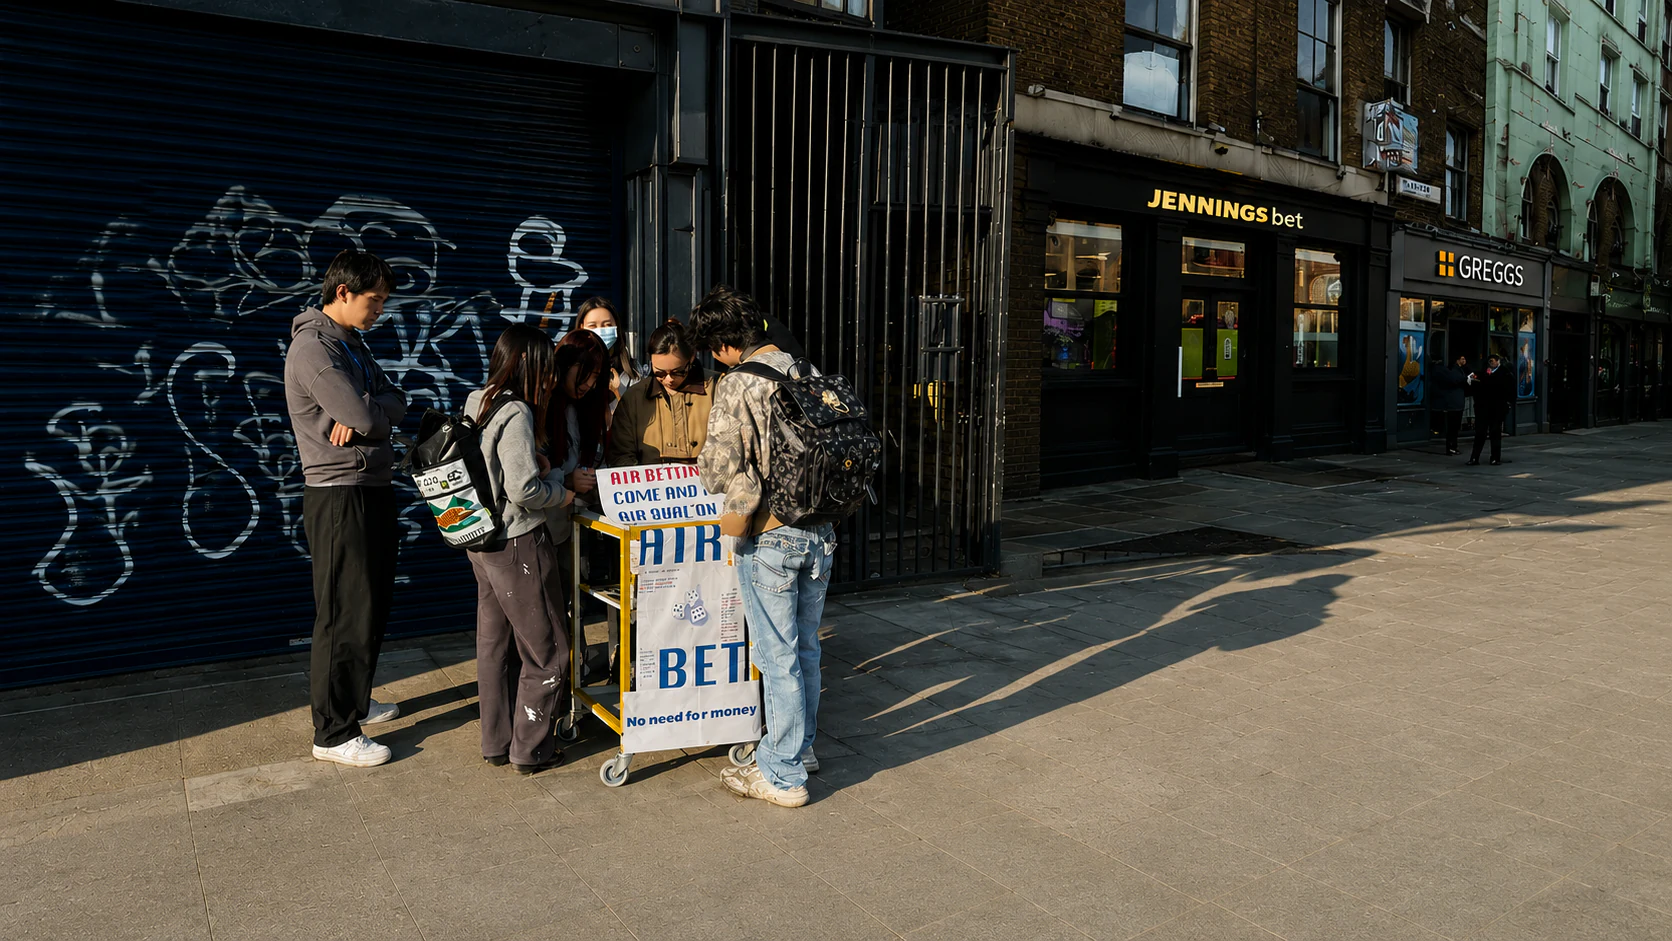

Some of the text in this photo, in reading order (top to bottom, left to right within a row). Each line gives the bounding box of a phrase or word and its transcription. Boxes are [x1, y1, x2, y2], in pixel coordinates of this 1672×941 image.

[1147, 189, 1304, 229] JENNINGS bet
[1459, 255, 1524, 287] GREGGS
[610, 470, 641, 485] AIR
[613, 488, 661, 505] COME
[665, 484, 698, 500] AND
[618, 509, 647, 522] AIR
[639, 524, 722, 566] AIR
[659, 641, 745, 690] BET
[626, 705, 757, 728] No need for money
